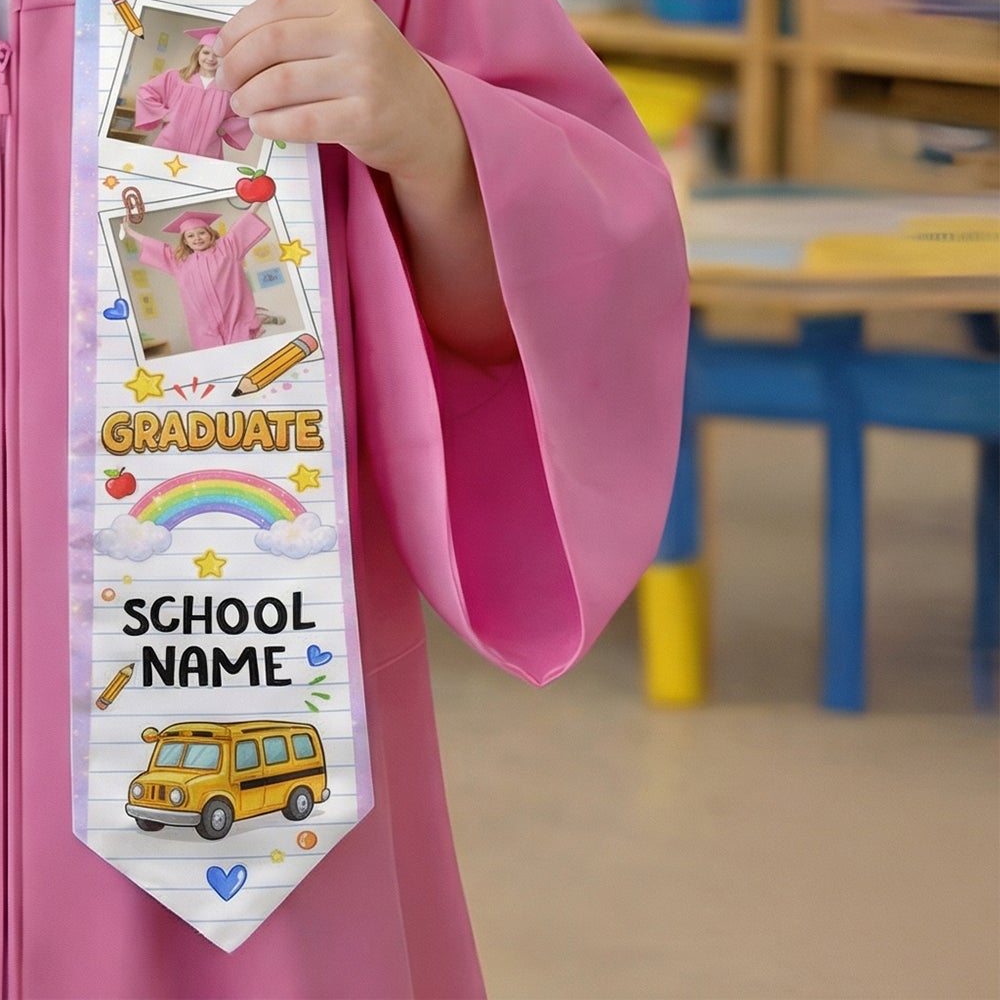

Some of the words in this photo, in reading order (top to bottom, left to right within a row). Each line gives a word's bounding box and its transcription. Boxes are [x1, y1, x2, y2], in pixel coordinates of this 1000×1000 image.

[102, 409, 324, 456] GRADUATE
[122, 591, 316, 636] SCHOOL
[142, 645, 292, 687] NAME
